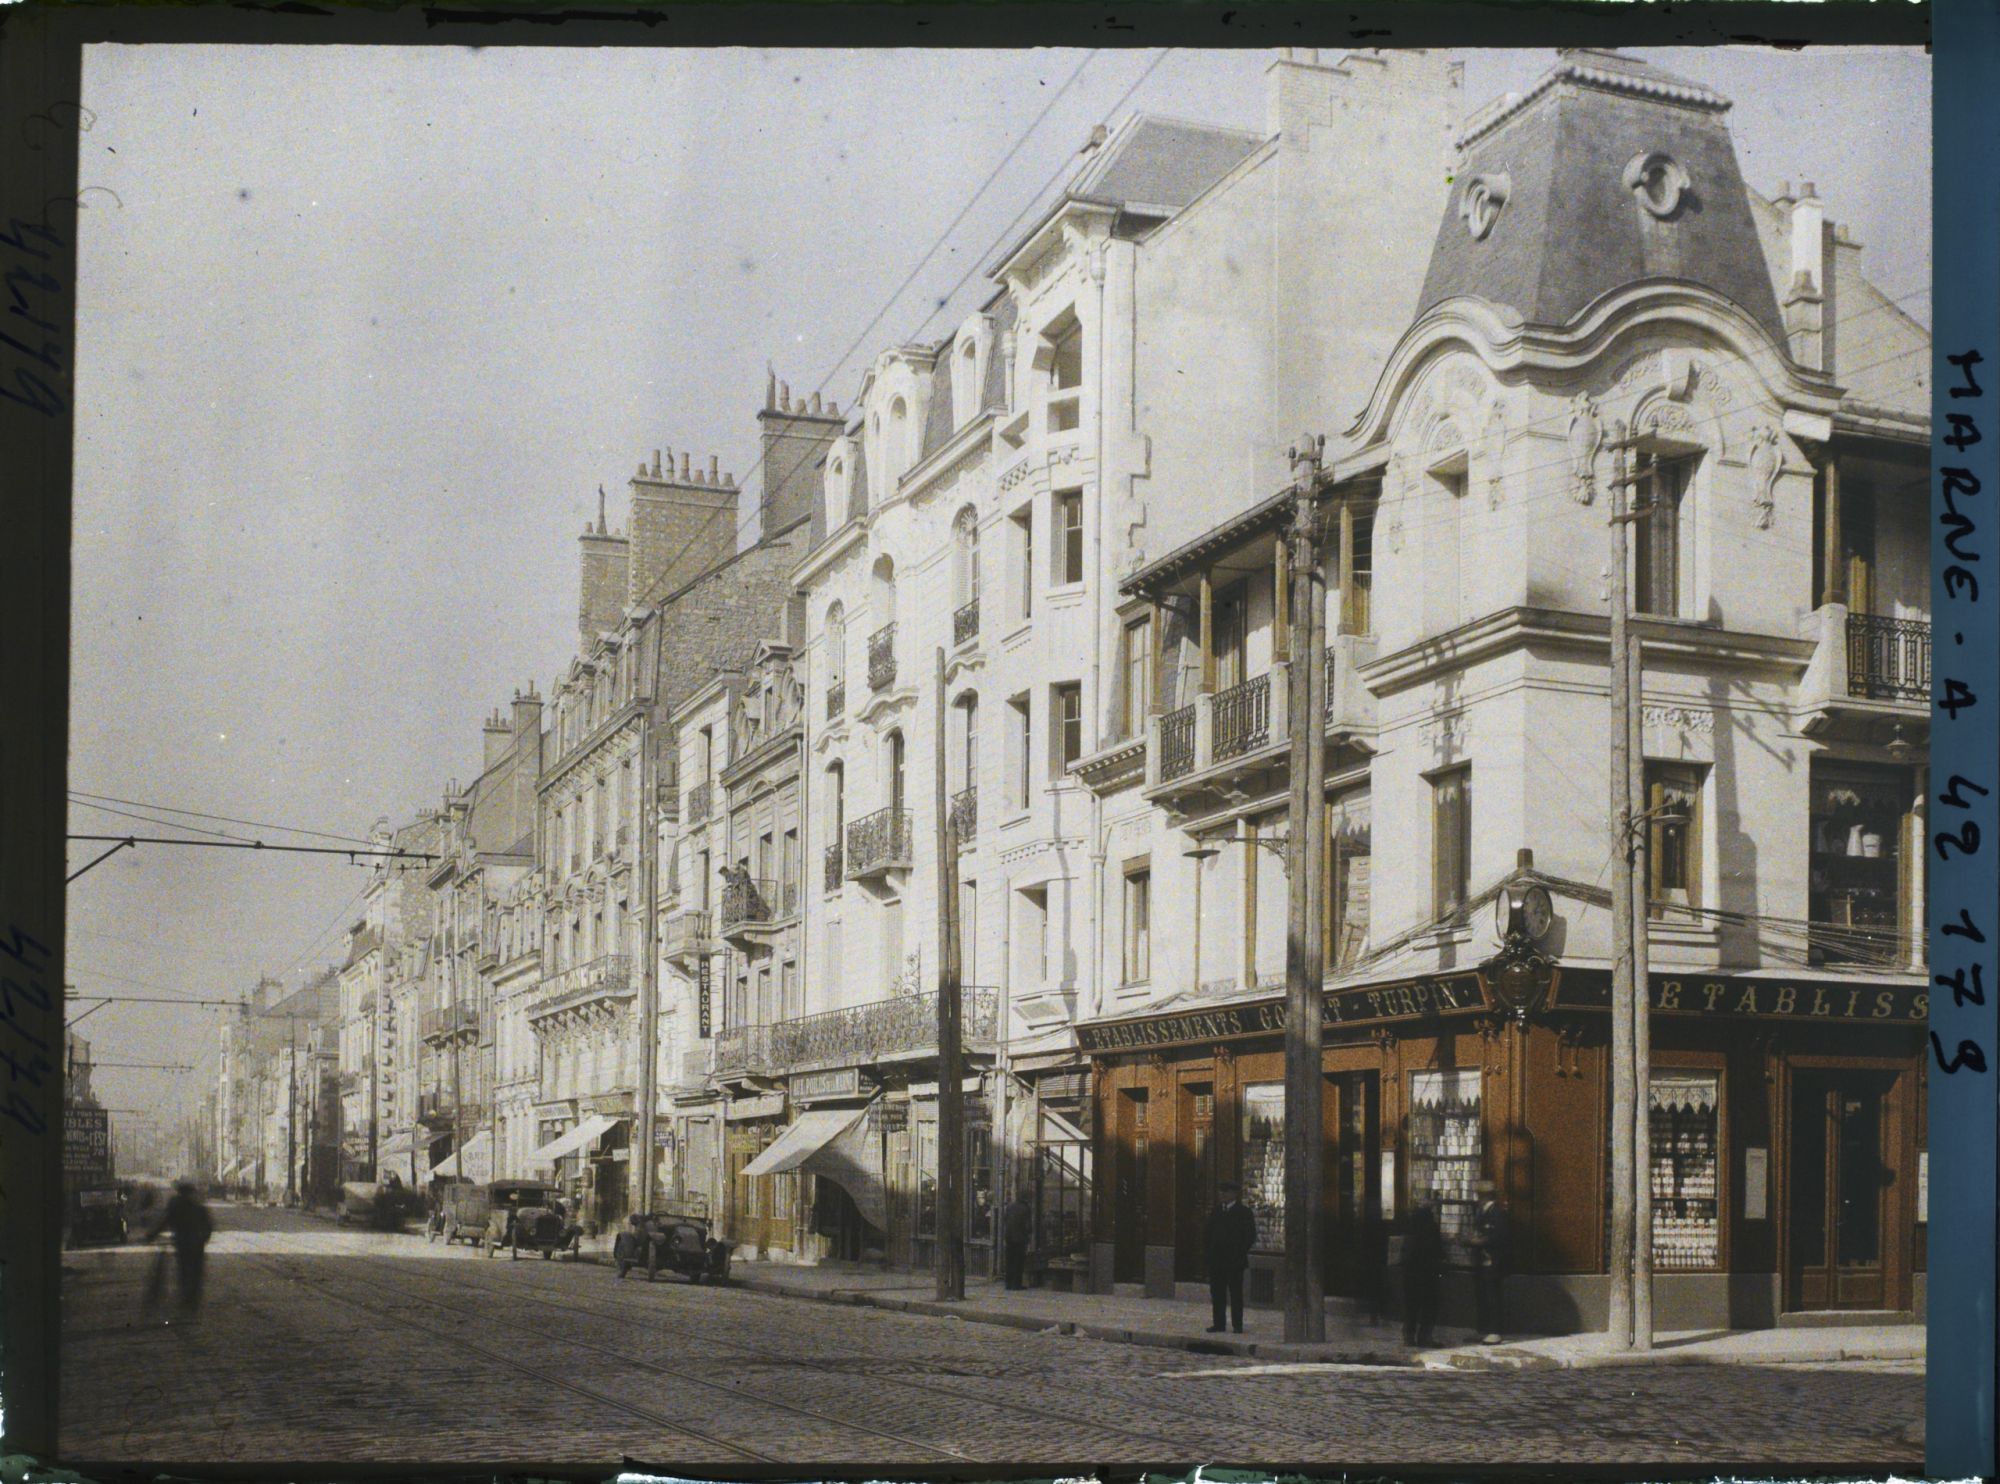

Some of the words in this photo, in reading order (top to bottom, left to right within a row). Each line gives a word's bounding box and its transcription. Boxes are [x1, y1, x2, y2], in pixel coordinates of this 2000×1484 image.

[1939, 349, 1984, 602] MARNE
[1938, 678, 1977, 720] A
[1934, 775, 1989, 861] 42
[701, 961, 709, 1033] RESTAURANT
[1092, 1011, 1242, 1048] ETABLISSEMENTS
[1259, 997, 1342, 1030] GOET
[1367, 982, 1459, 1017] TURPIN
[1657, 981, 1929, 1019] ETABLISS
